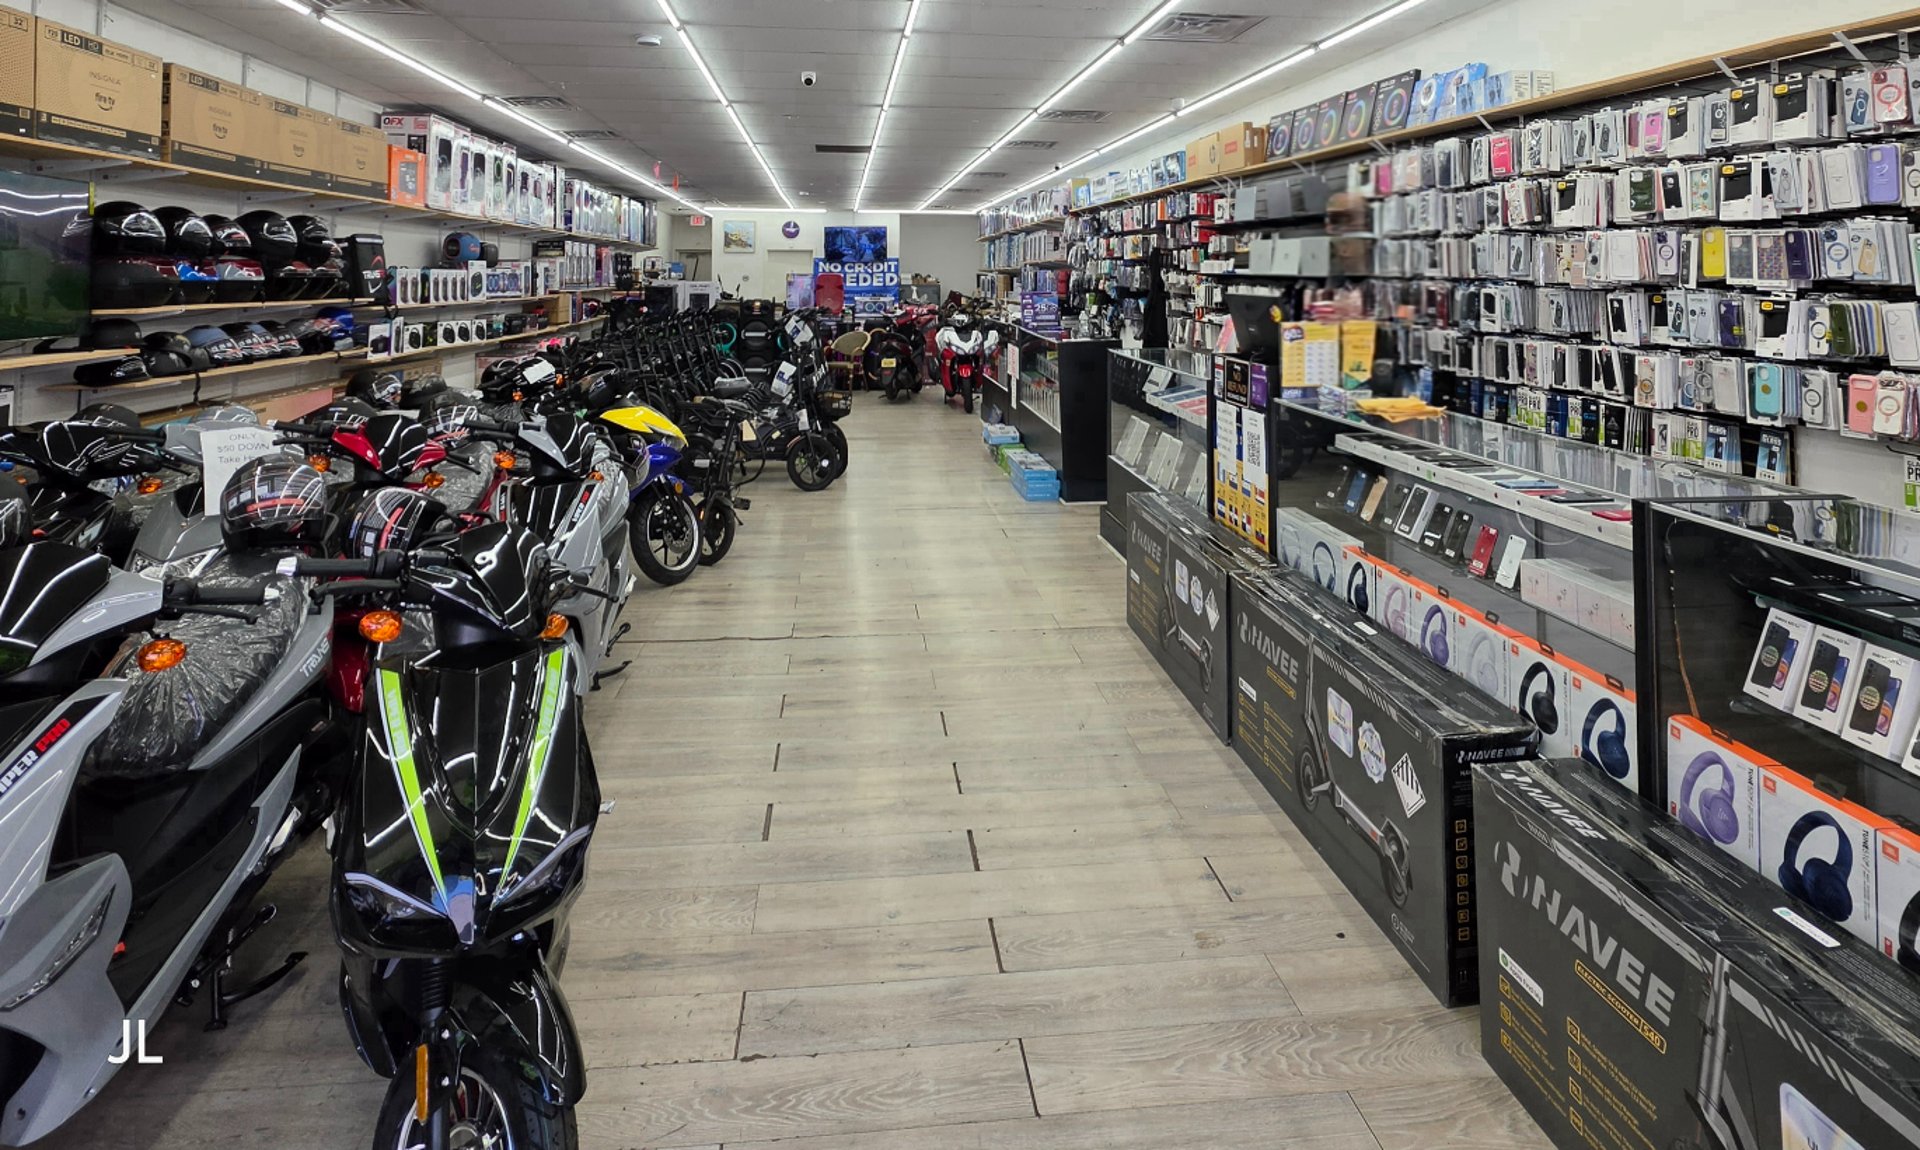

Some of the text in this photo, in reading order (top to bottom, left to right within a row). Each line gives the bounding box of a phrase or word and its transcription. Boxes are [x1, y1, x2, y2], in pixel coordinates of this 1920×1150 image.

[64, 34, 99, 51] LED HD
[89, 71, 121, 86] INSIGNIA
[192, 75, 203, 86] LED
[95, 92, 108, 103] fire
[383, 117, 404, 126] OFX
[818, 261, 841, 273] NO
[846, 273, 897, 286] EDED
[1708, 424, 1727, 436] GLASS
[229, 433, 257, 441] ONLY
[1762, 434, 1782, 445] GLASS
[238, 443, 270, 451] DOWN
[218, 456, 241, 464] Take
[1907, 467, 1920, 480] PR
[1137, 530, 1162, 563] NAVEE
[1252, 625, 1299, 684] NAVEE
[0, 718, 71, 795] IPER PRO
[1467, 748, 1504, 762] NAVEE
[1526, 786, 1607, 841] NAVEE
[1531, 875, 1675, 1027] NAVEE
[1578, 965, 1607, 997] ELECTRIC
[1607, 993, 1639, 1025] SCOOTER
